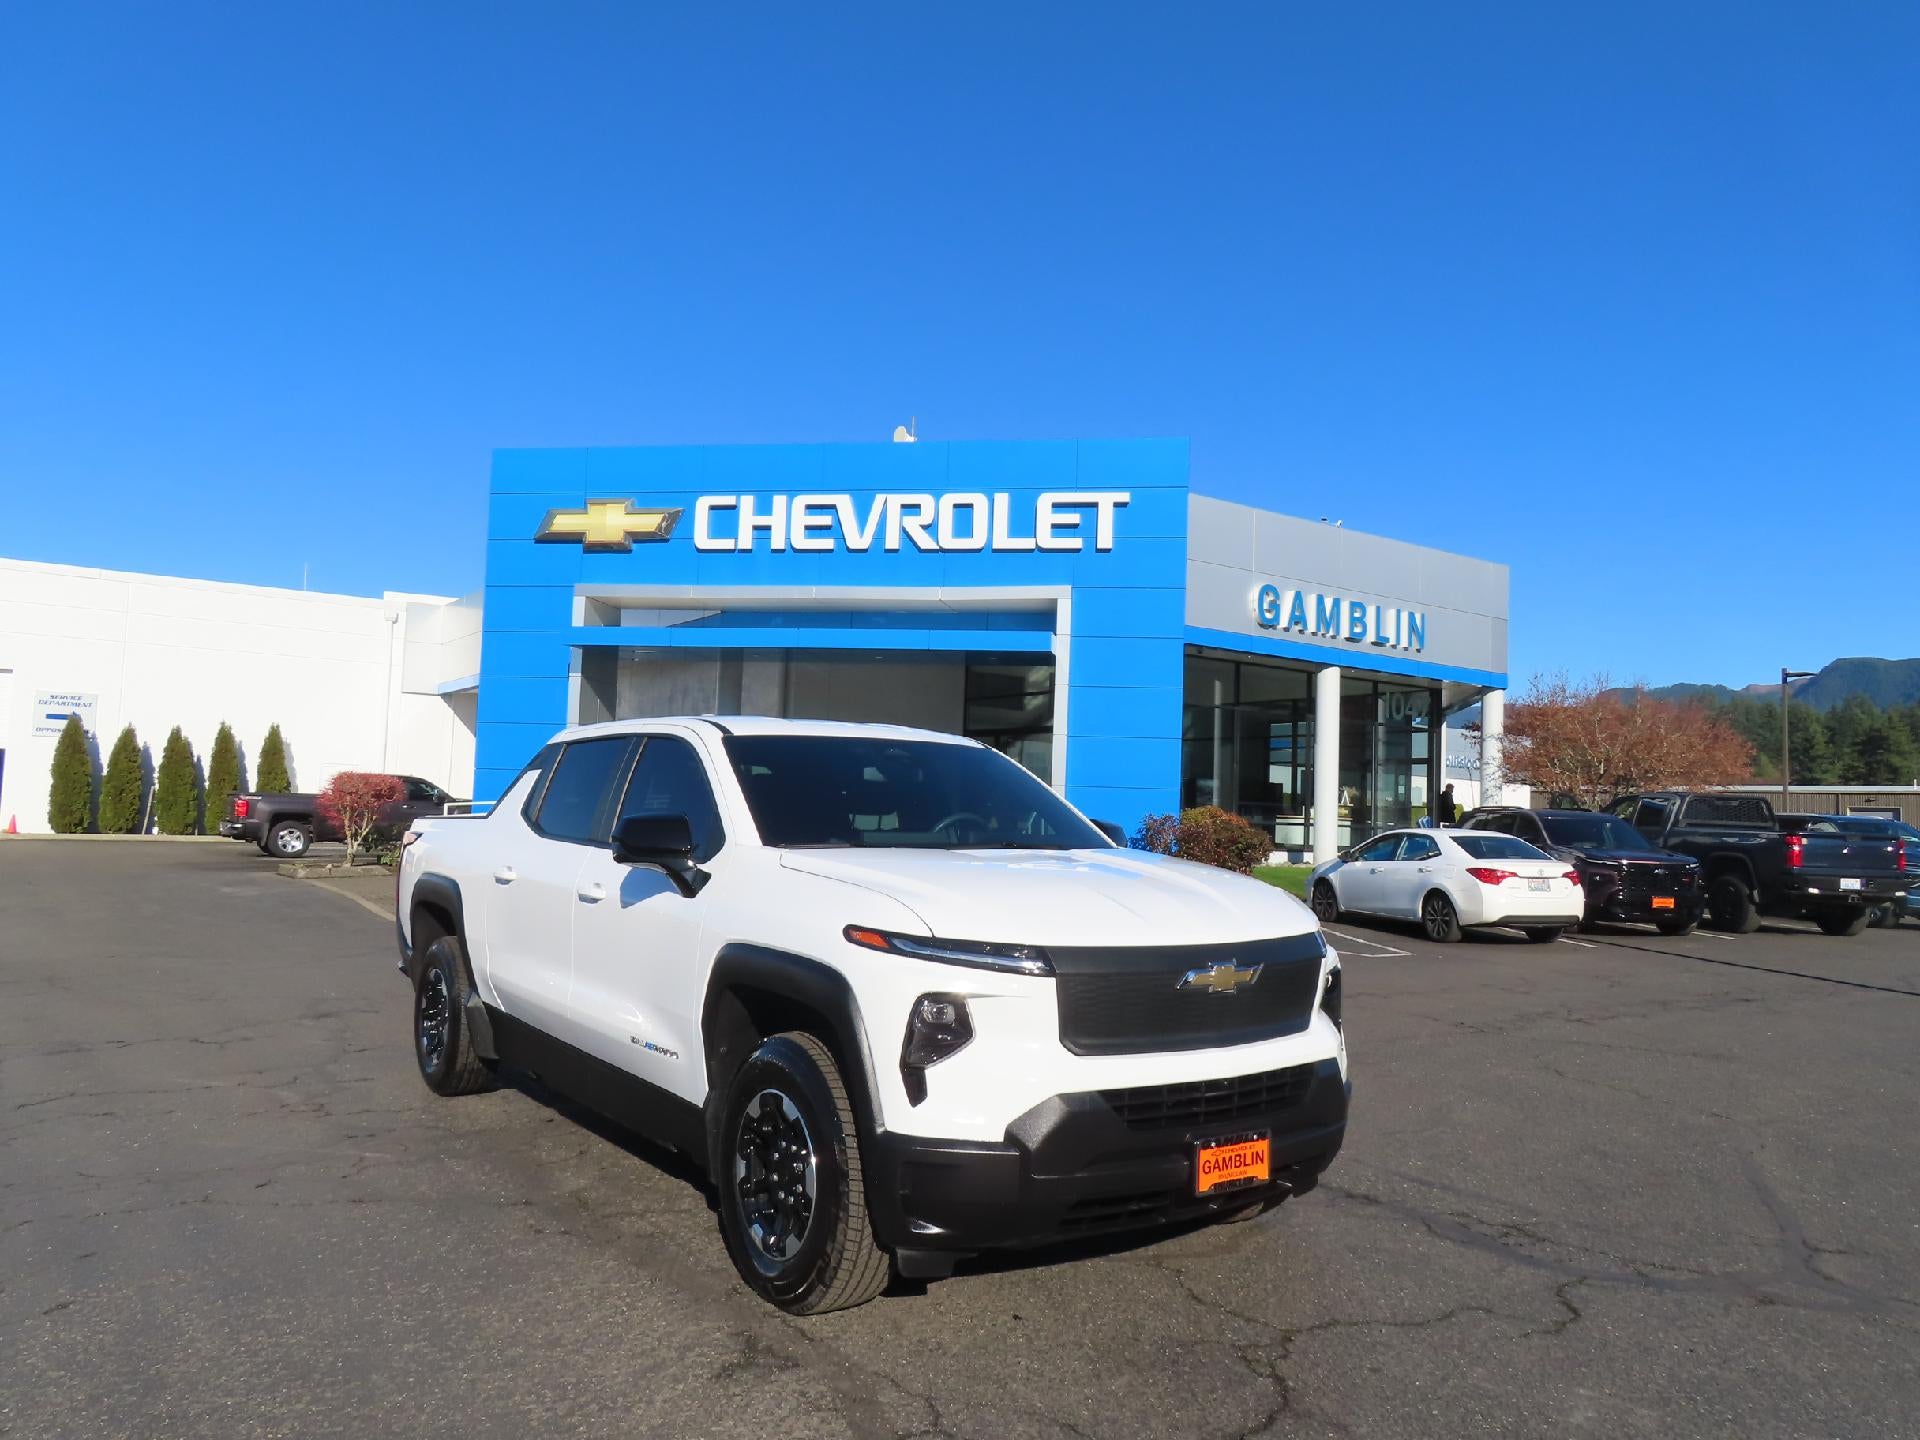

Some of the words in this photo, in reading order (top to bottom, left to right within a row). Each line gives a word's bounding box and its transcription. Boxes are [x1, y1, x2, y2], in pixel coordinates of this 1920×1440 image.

[694, 492, 1130, 553] CHEVROLET
[1254, 583, 1425, 652] GAMBLIN
[38, 699, 93, 708] DEPARTMENT
[35, 726, 65, 734] OPPOS
[1202, 1149, 1264, 1175] GAMBLIN
